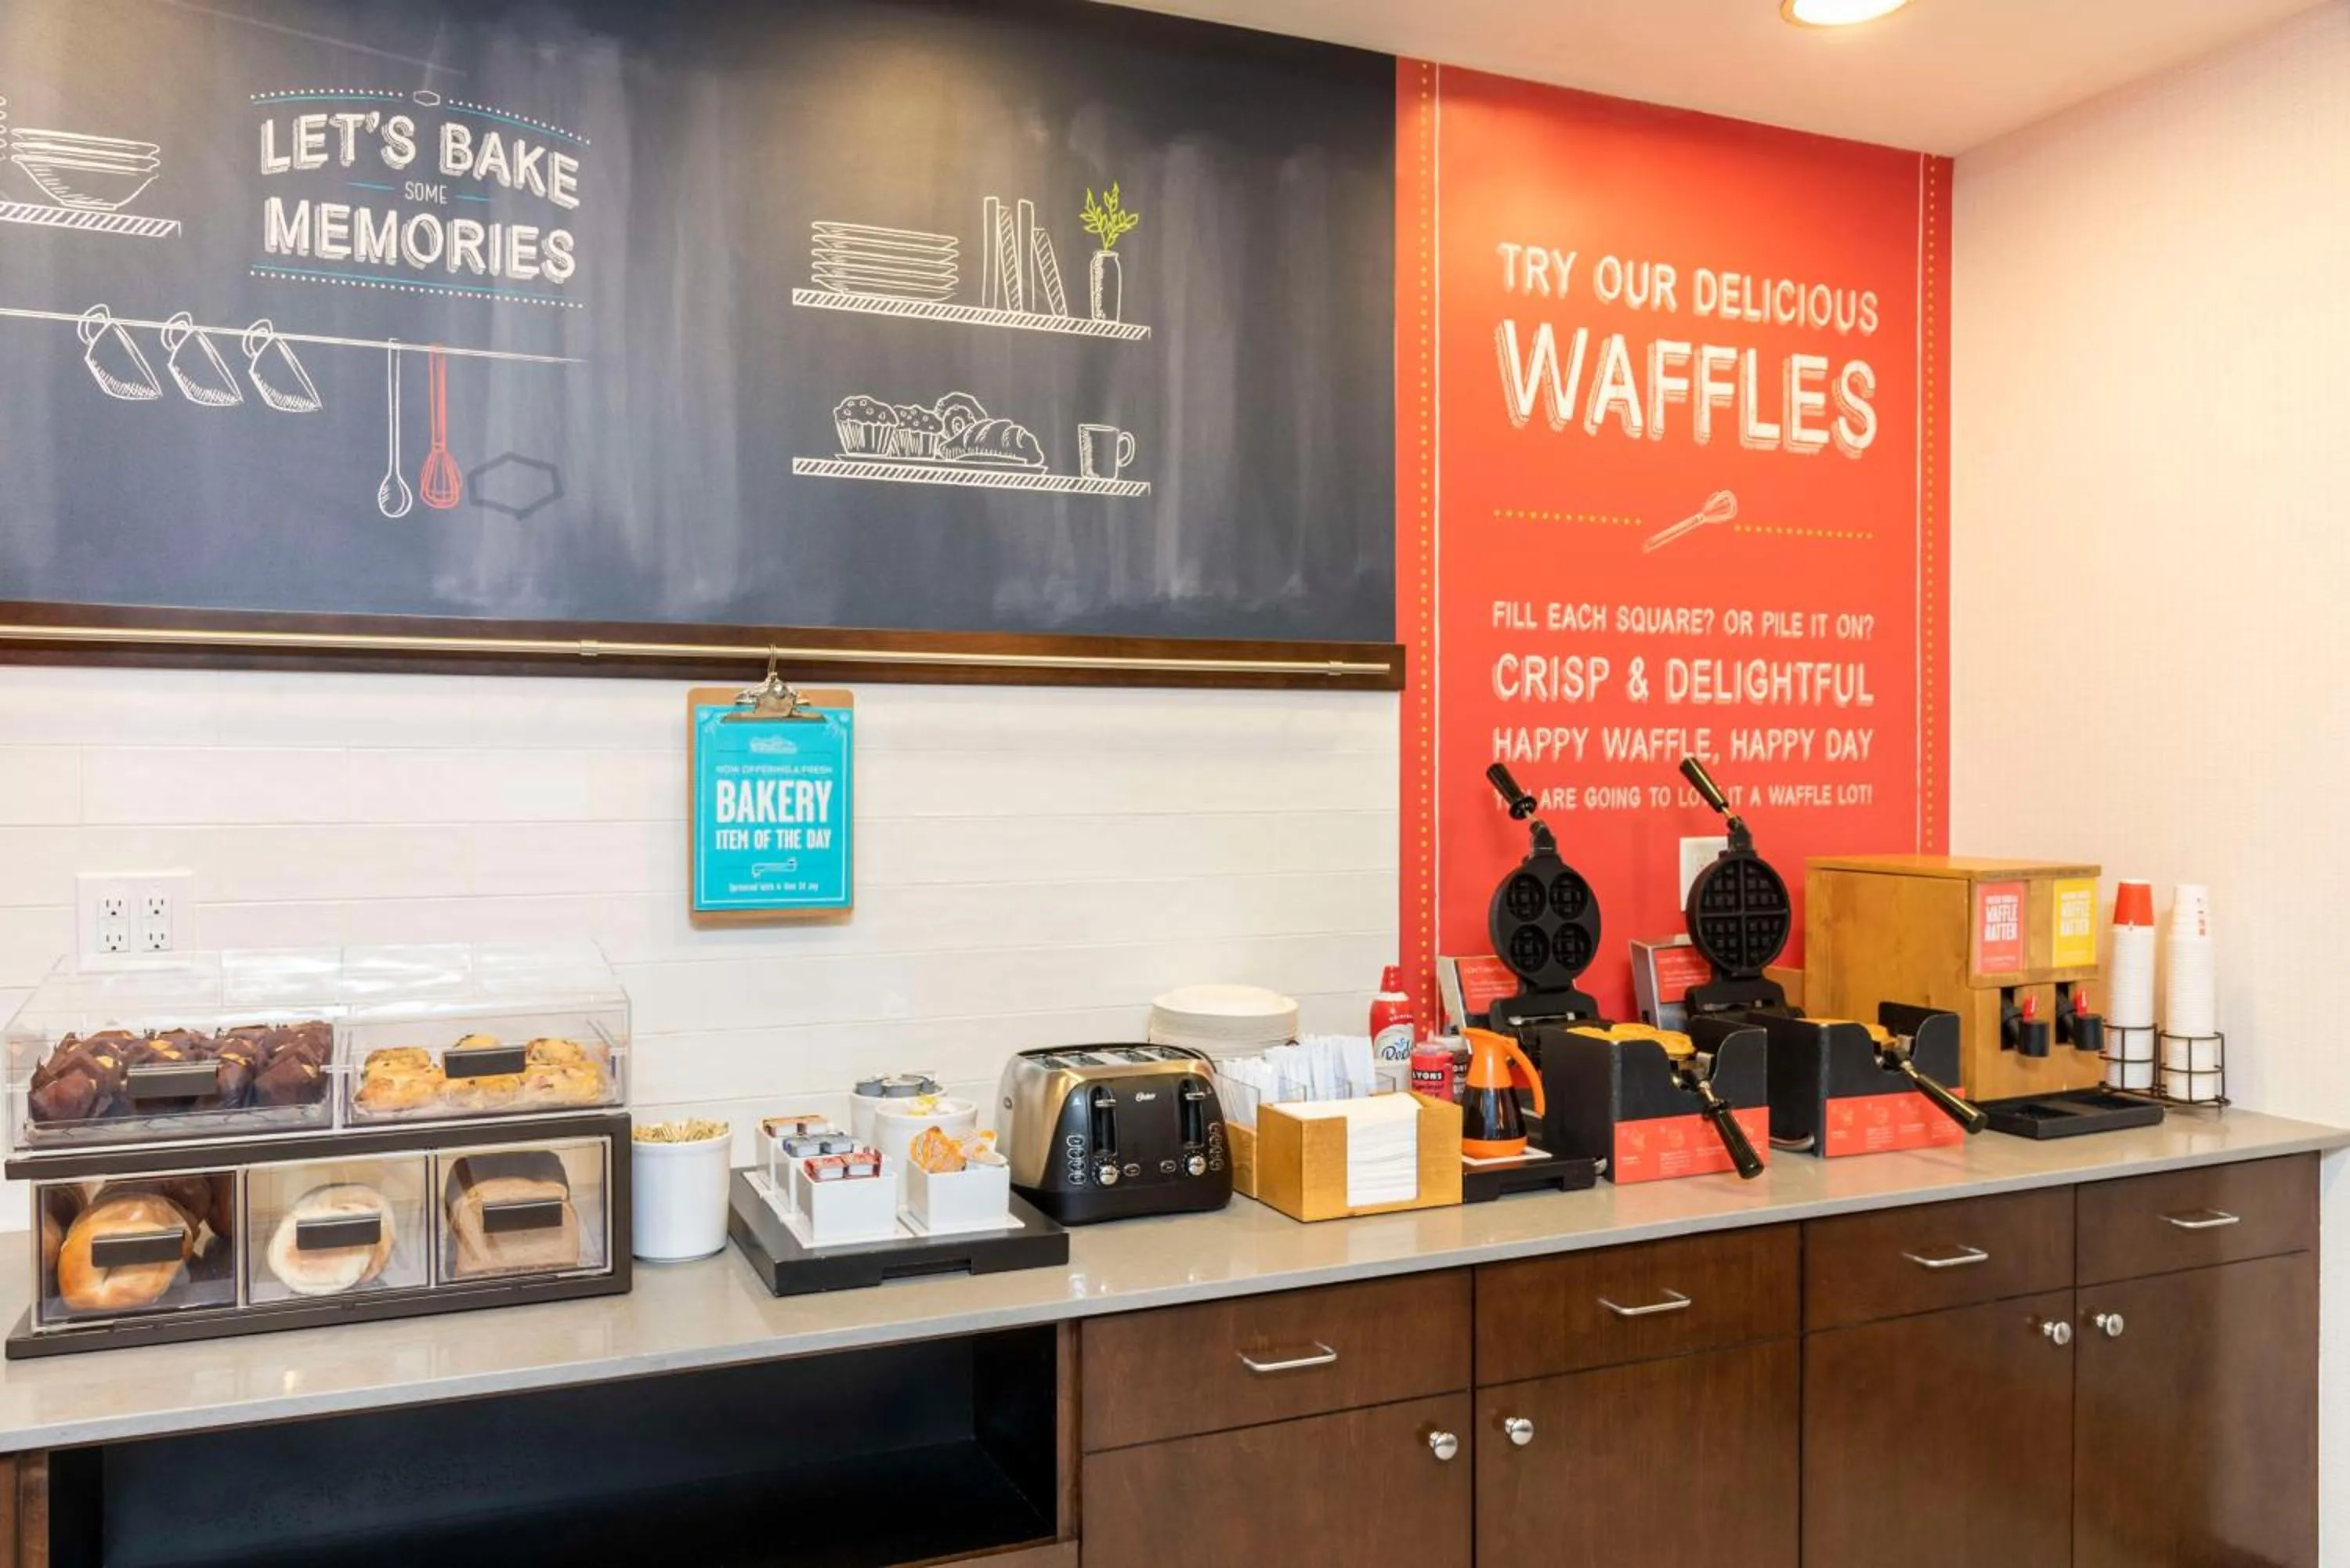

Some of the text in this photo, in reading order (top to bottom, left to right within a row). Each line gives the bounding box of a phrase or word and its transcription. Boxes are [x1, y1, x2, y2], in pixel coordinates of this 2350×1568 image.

[261, 110, 580, 210] LET'S BAKE
[405, 181, 447, 204] SOME
[264, 197, 576, 284] MEMORIES
[1496, 241, 1878, 337] TRY OUR DELICIOUS
[1493, 319, 1878, 460] WAFFLES
[1492, 601, 1875, 641] FILL EACH SQUARE? OR PILE IT ON?
[1492, 652, 1875, 708] CRISP & DELIGHTFUL
[1492, 726, 1875, 766] HAPPY WAFFLE, HAPPY DAY
[716, 779, 833, 823] BAKERY
[1540, 787, 1577, 810] ARE
[1585, 786, 1641, 809] GOING
[1650, 787, 1671, 809] TO
[1678, 786, 1723, 808] LO
[1728, 786, 1743, 806] IT
[1750, 786, 1761, 806] A
[1768, 785, 1831, 806] WAFFLE
[1838, 783, 1873, 804] LOT!
[715, 829, 831, 850] ITEM OF THE DAY
[1986, 904, 2019, 923] WAFFLE
